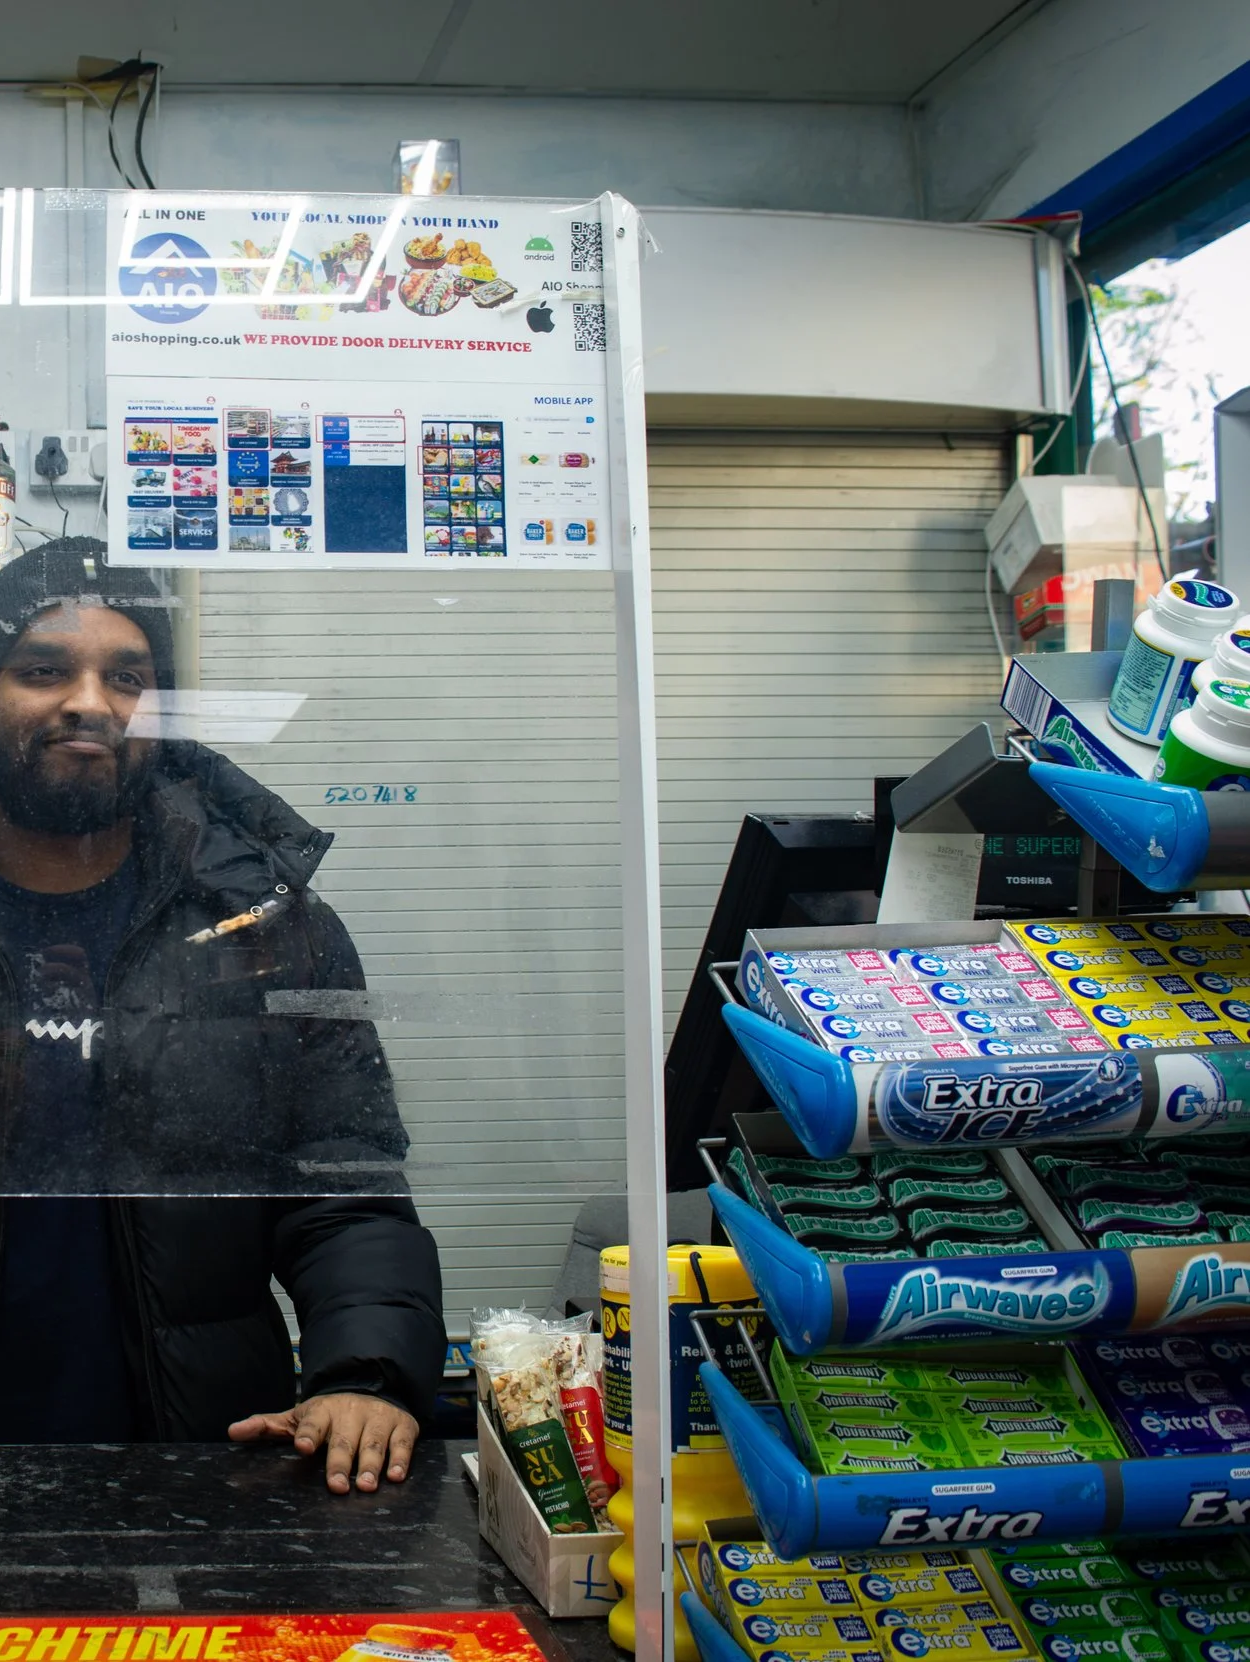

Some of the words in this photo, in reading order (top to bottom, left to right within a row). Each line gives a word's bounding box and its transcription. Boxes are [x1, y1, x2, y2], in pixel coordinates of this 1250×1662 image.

[156, 210, 171, 220] IN
[175, 210, 206, 221] ONE
[347, 214, 387, 225] SHOP
[412, 216, 451, 228] YOUR
[457, 218, 500, 229] HAND
[524, 253, 555, 261] android
[111, 332, 241, 346] aioshopping.co.uk
[243, 333, 268, 346] WE
[271, 334, 338, 347] PROVIDE
[341, 336, 384, 348] DOOR
[388, 337, 464, 350] DELIVERY
[467, 339, 532, 352] SERVICE
[534, 396, 572, 406] MOBILE
[574, 396, 594, 405] APP
[179, 528, 213, 537] SERVICES
[1006, 876, 1053, 885] TOSHIBA
[768, 954, 836, 971] extra
[1008, 1064, 1033, 1072] Sugarfree
[1035, 1063, 1047, 1071] Gum
[1060, 1061, 1098, 1070] Microgranules
[925, 1077, 1042, 1110] Extra
[938, 1109, 1048, 1143] ICE
[894, 1178, 1004, 1206] Airwaves
[1003, 1268, 1038, 1277] SUGARFREE
[1039, 1267, 1055, 1275] GUM
[880, 1272, 1097, 1334] Airwaves
[812, 1364, 881, 1378] DOUBLEMINT
[519, 1432, 552, 1449] cretamel
[836, 1426, 906, 1441] DOUBLEMINT
[523, 1445, 556, 1469] NU
[530, 1463, 564, 1486] GA
[934, 1485, 974, 1494] SUGARFREE
[976, 1484, 993, 1492] GUM
[544, 1500, 570, 1514] PISTACHIO
[878, 1506, 1043, 1545] Extra
[1011, 1567, 1077, 1583] extra
[735, 1579, 805, 1602] extra
